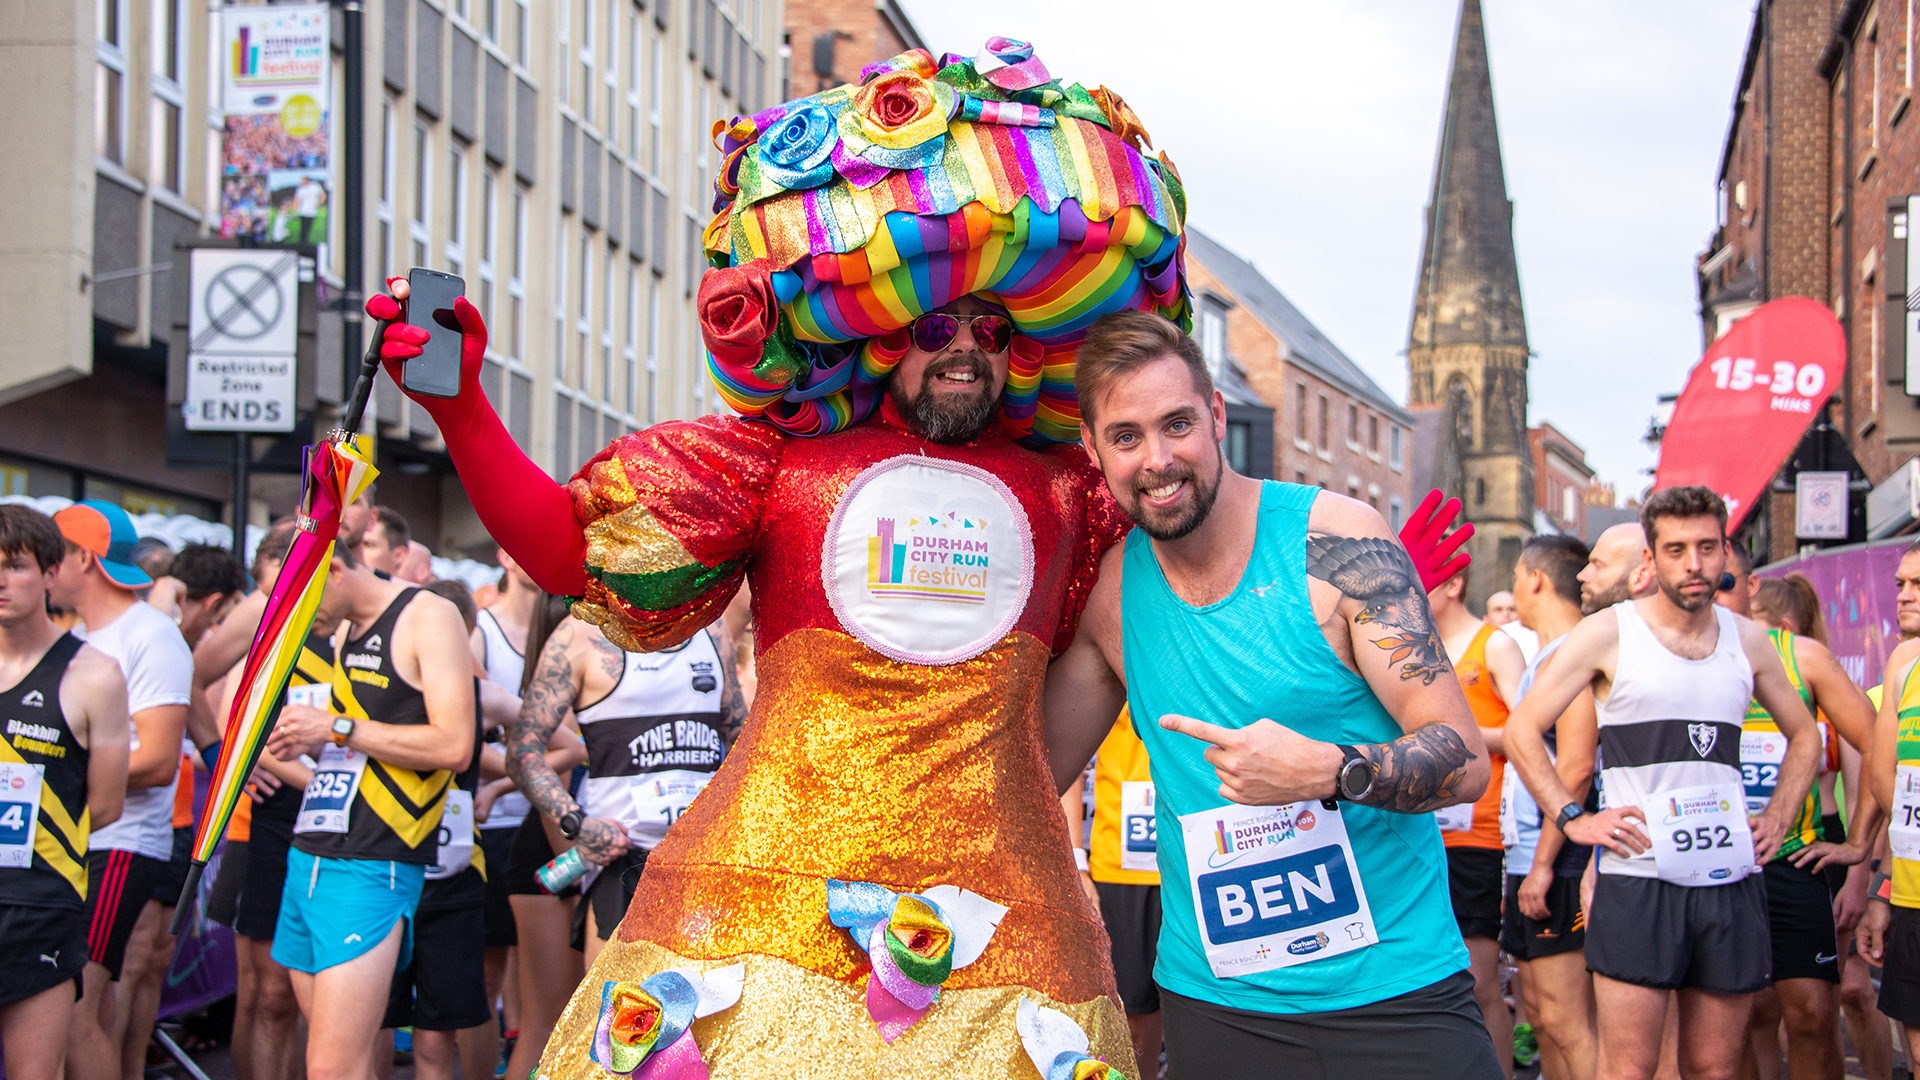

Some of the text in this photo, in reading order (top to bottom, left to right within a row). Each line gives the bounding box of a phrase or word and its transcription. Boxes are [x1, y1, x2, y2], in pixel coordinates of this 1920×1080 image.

[198, 361, 287, 374] Restricted
[1710, 356, 1826, 397] 15-30
[222, 379, 261, 392] Zone
[202, 400, 281, 421] ENDS
[1770, 396, 1812, 413] MINS
[912, 536, 988, 553] DURHAM
[910, 550, 989, 567] CITY RUN
[909, 564, 988, 588] festival
[7, 718, 61, 744] Blackhill
[628, 719, 721, 757] TYNE BRIDG
[1683, 801, 1717, 809] DURHAM
[1683, 808, 1702, 816] CITY
[1235, 819, 1293, 840] DURHAM
[1236, 828, 1296, 851] CITY RUN
[1672, 825, 1734, 852] 952
[1216, 863, 1336, 927] BEN
[1290, 939, 1317, 950] Durham
